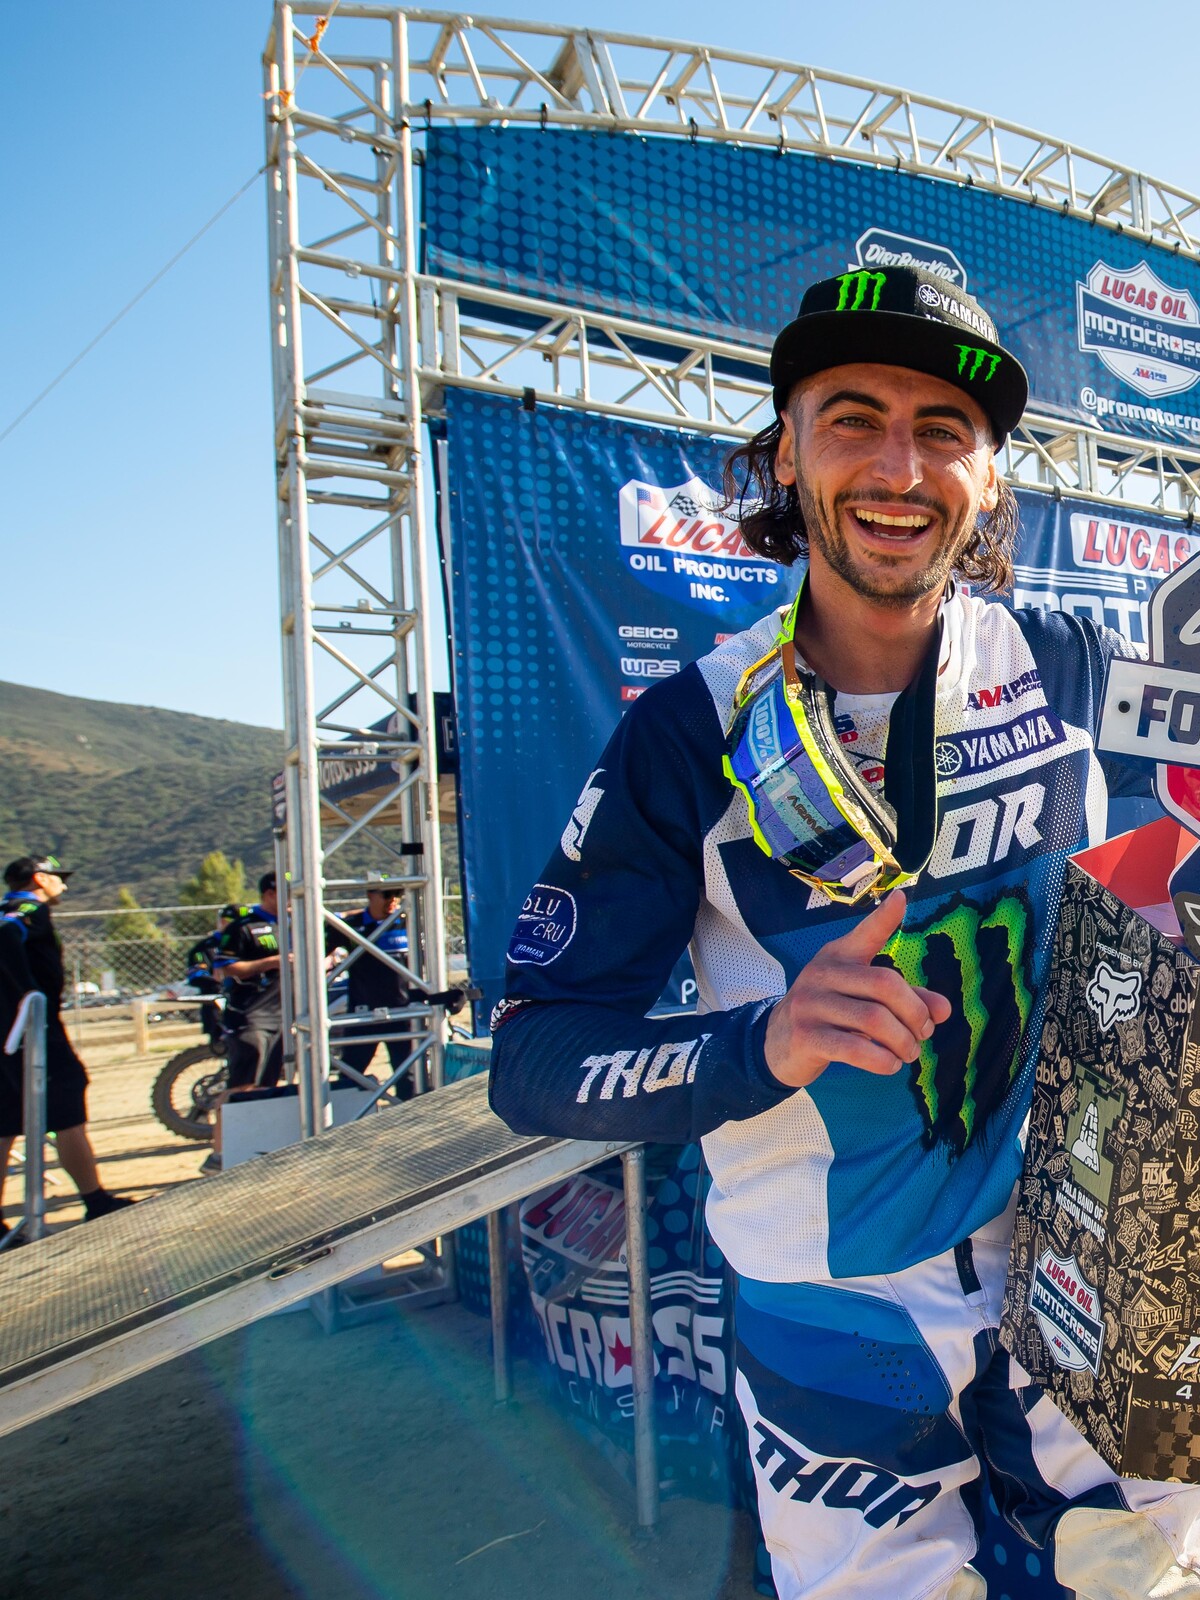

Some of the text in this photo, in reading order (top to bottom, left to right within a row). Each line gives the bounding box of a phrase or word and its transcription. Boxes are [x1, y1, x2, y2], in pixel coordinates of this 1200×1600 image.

[1101, 276, 1188, 320] LUCAS OIL
[940, 294, 995, 343] YAMAHA
[1131, 316, 1163, 331] PRO
[629, 554, 778, 584] OIL PRODUCTS
[690, 583, 730, 602] INC.
[618, 626, 678, 639] GEICO
[626, 641, 671, 650] MOTORCYCLE
[620, 657, 681, 677] WPS
[963, 684, 1014, 711] AMA
[961, 715, 1056, 768] YAMAHA
[1095, 941, 1143, 970] PRESENTED BY
[1062, 1179, 1104, 1221] PALA BAND OF
[1056, 1190, 1080, 1221] MISSION
[1080, 1212, 1106, 1242] INDIANS
[1046, 1259, 1094, 1314] LUCAS OIL
[1034, 1281, 1099, 1353] MOTOCROSS
[1158, 1305, 1182, 1325] KIDZ
[753, 1420, 943, 1530] THOR
